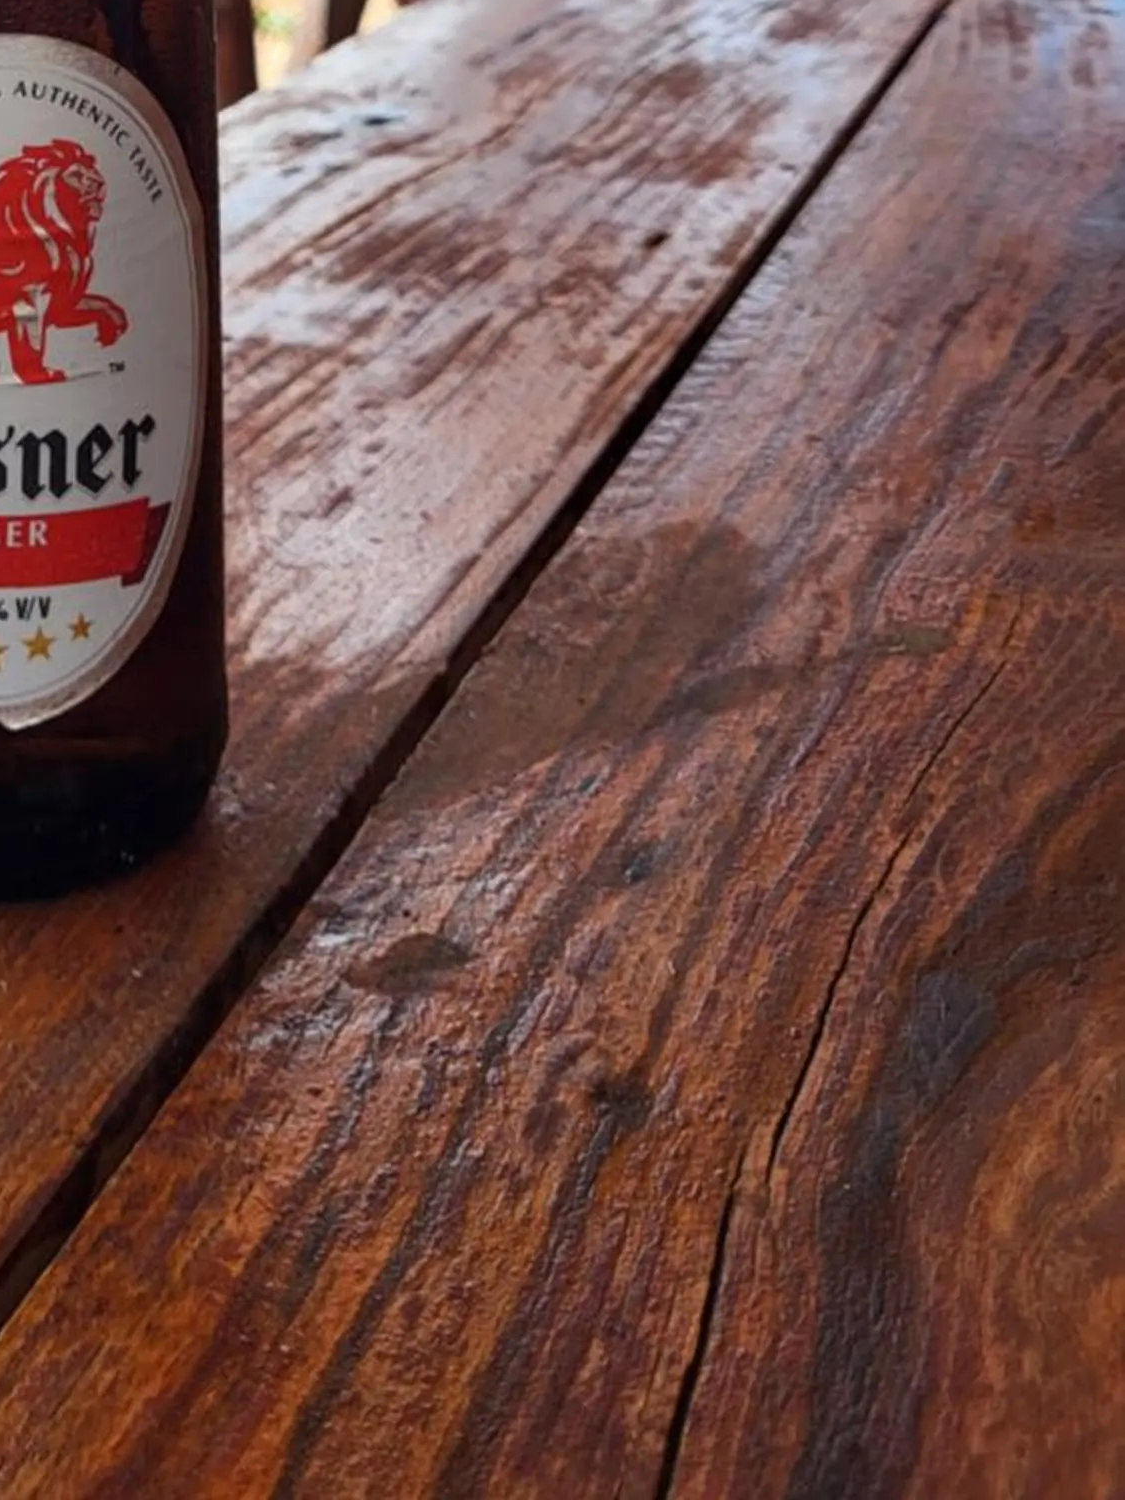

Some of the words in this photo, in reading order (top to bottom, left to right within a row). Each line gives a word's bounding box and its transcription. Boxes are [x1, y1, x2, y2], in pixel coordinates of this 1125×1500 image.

[12, 80, 131, 148] AUTHENTIC
[128, 143, 164, 204] TASTE
[15, 596, 52, 621] V/V
